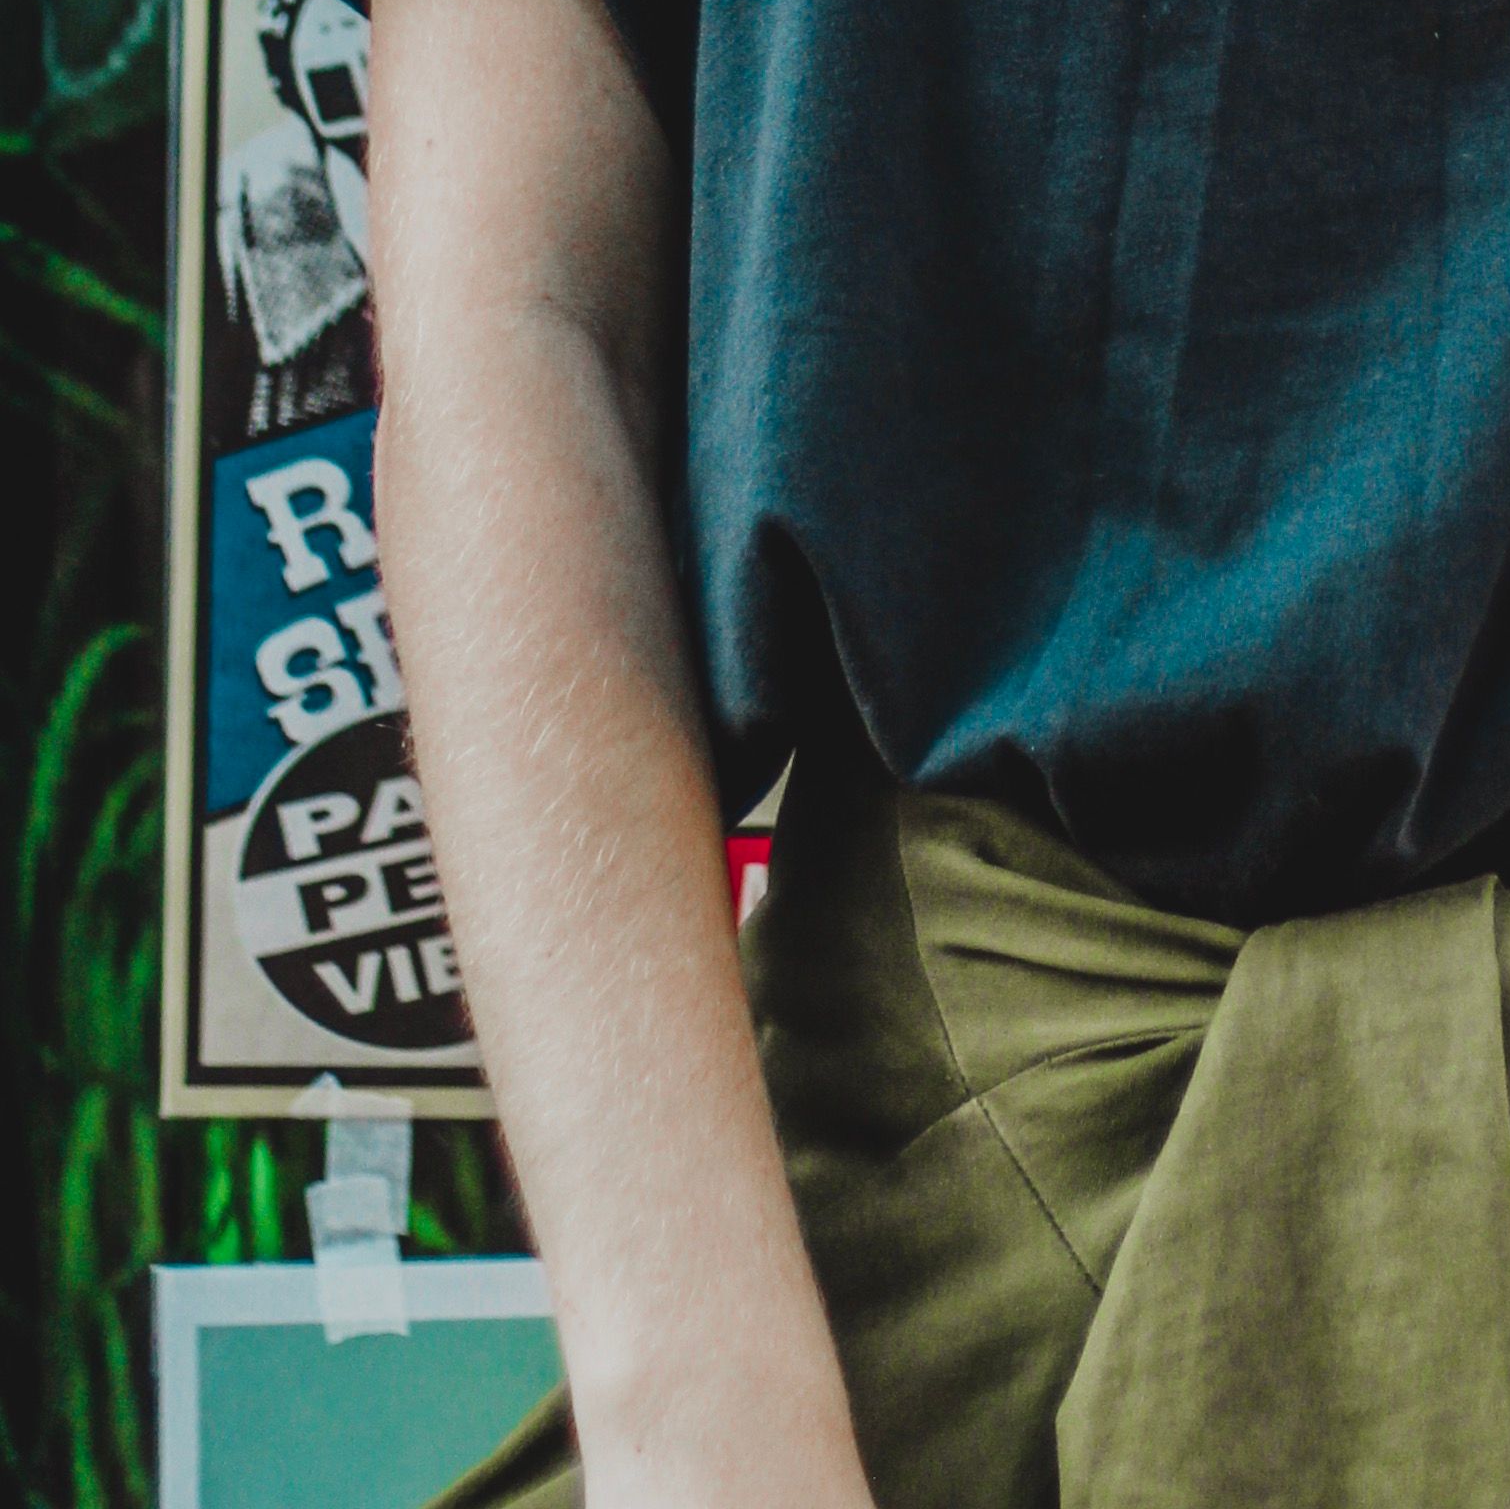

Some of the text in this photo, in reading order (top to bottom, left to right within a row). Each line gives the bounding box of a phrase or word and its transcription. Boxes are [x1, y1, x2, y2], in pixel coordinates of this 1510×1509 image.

[277, 773, 430, 862] PA
[297, 853, 446, 934] PE
[313, 934, 464, 1017] VIE
